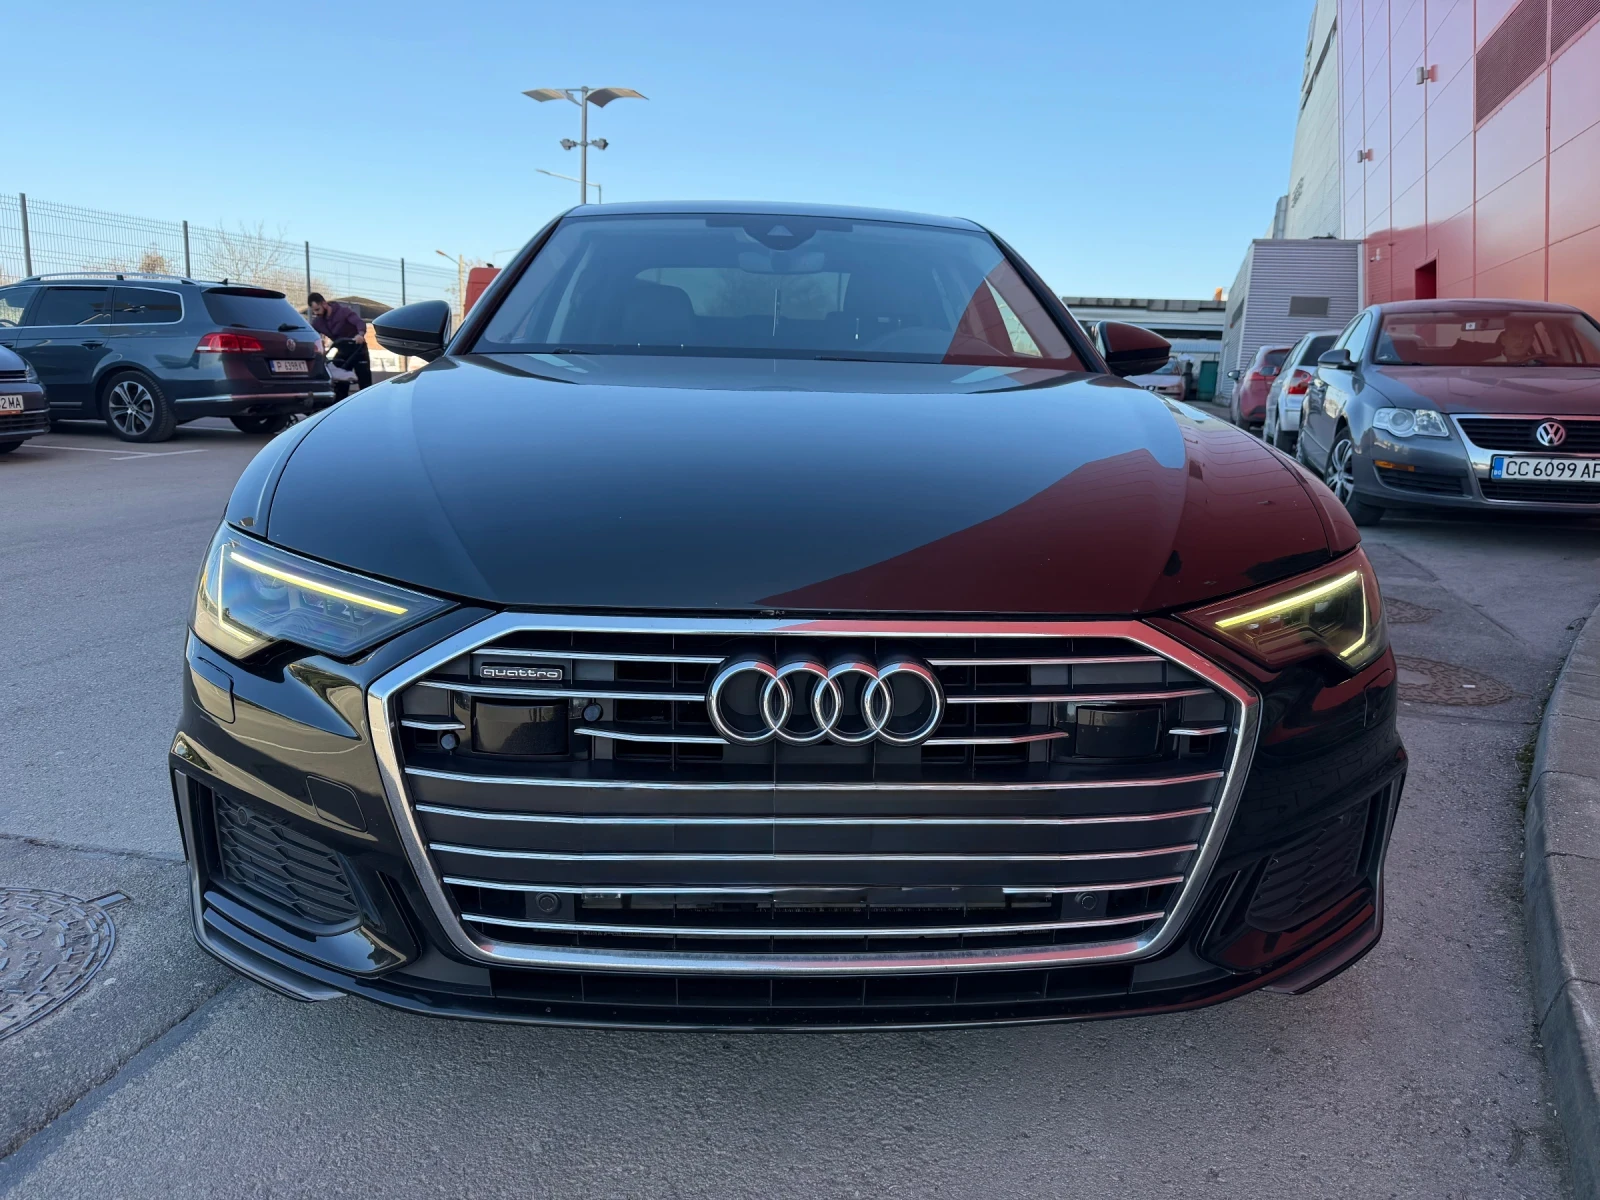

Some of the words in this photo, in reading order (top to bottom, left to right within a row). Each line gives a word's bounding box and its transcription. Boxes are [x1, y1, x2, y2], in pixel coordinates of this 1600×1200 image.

[1506, 461, 1530, 476] CC
[1533, 462, 1577, 478] 6099
[483, 668, 558, 678] quattro
